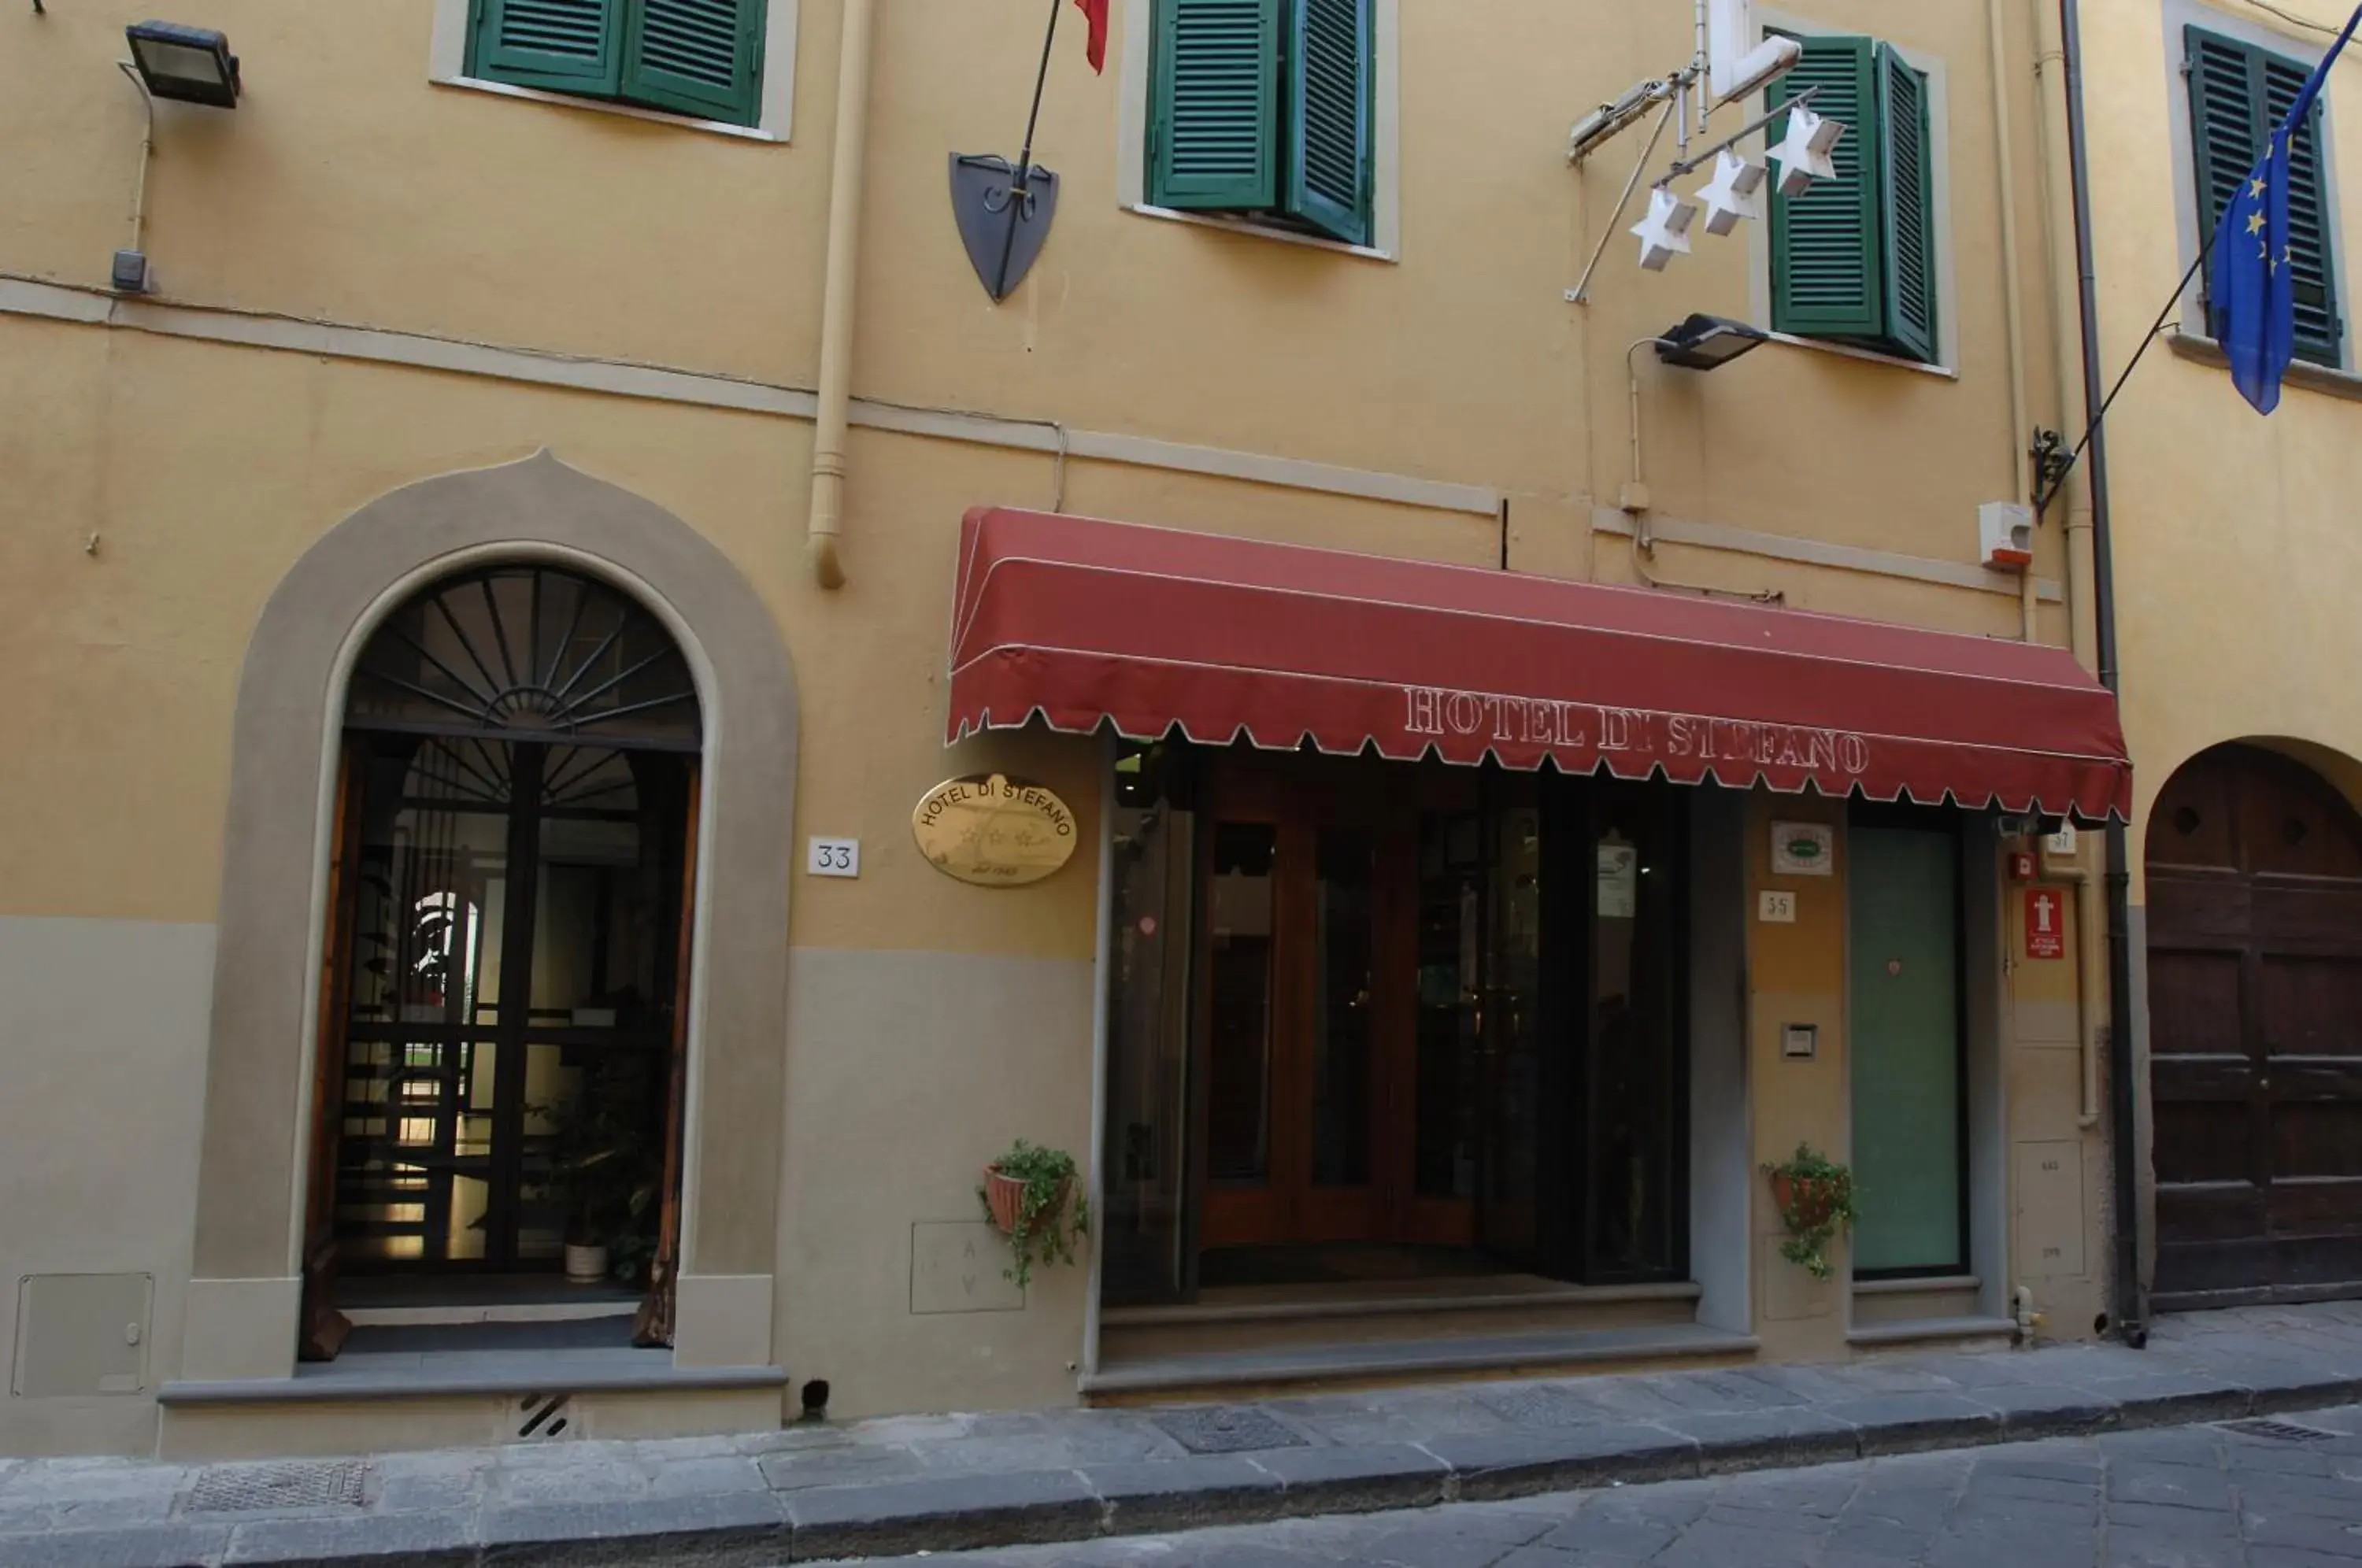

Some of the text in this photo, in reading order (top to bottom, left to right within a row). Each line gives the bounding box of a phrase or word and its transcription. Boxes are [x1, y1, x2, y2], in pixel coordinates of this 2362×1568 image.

[1404, 686, 1869, 774] HOTEL DI STEFANO
[921, 782, 1070, 836] HOTEL DI STEFANO
[817, 845, 850, 869] 33
[1768, 897, 1787, 915] 35
